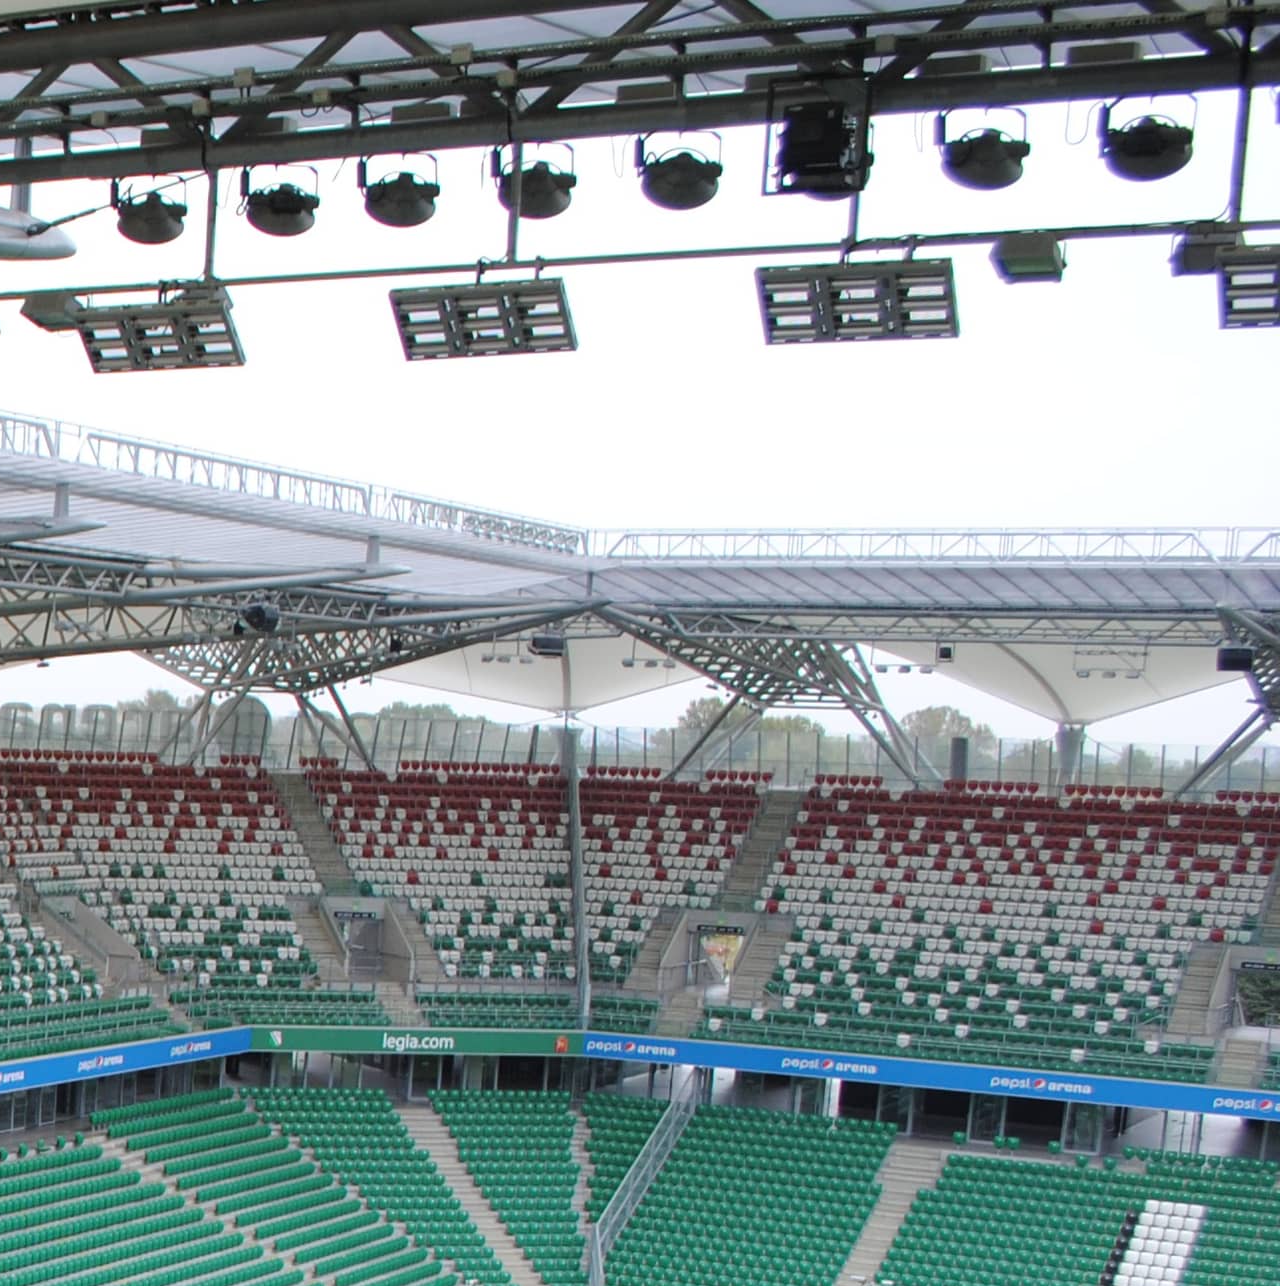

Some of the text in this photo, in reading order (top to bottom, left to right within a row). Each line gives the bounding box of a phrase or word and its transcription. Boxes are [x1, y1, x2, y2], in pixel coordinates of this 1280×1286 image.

[382, 1031, 455, 1053] legia.com
[586, 1040, 676, 1057] pepsi arena
[781, 1057, 878, 1075] pepsi arena
[990, 1076, 1093, 1095] pepsi arena
[1212, 1097, 1256, 1109] pepsi
